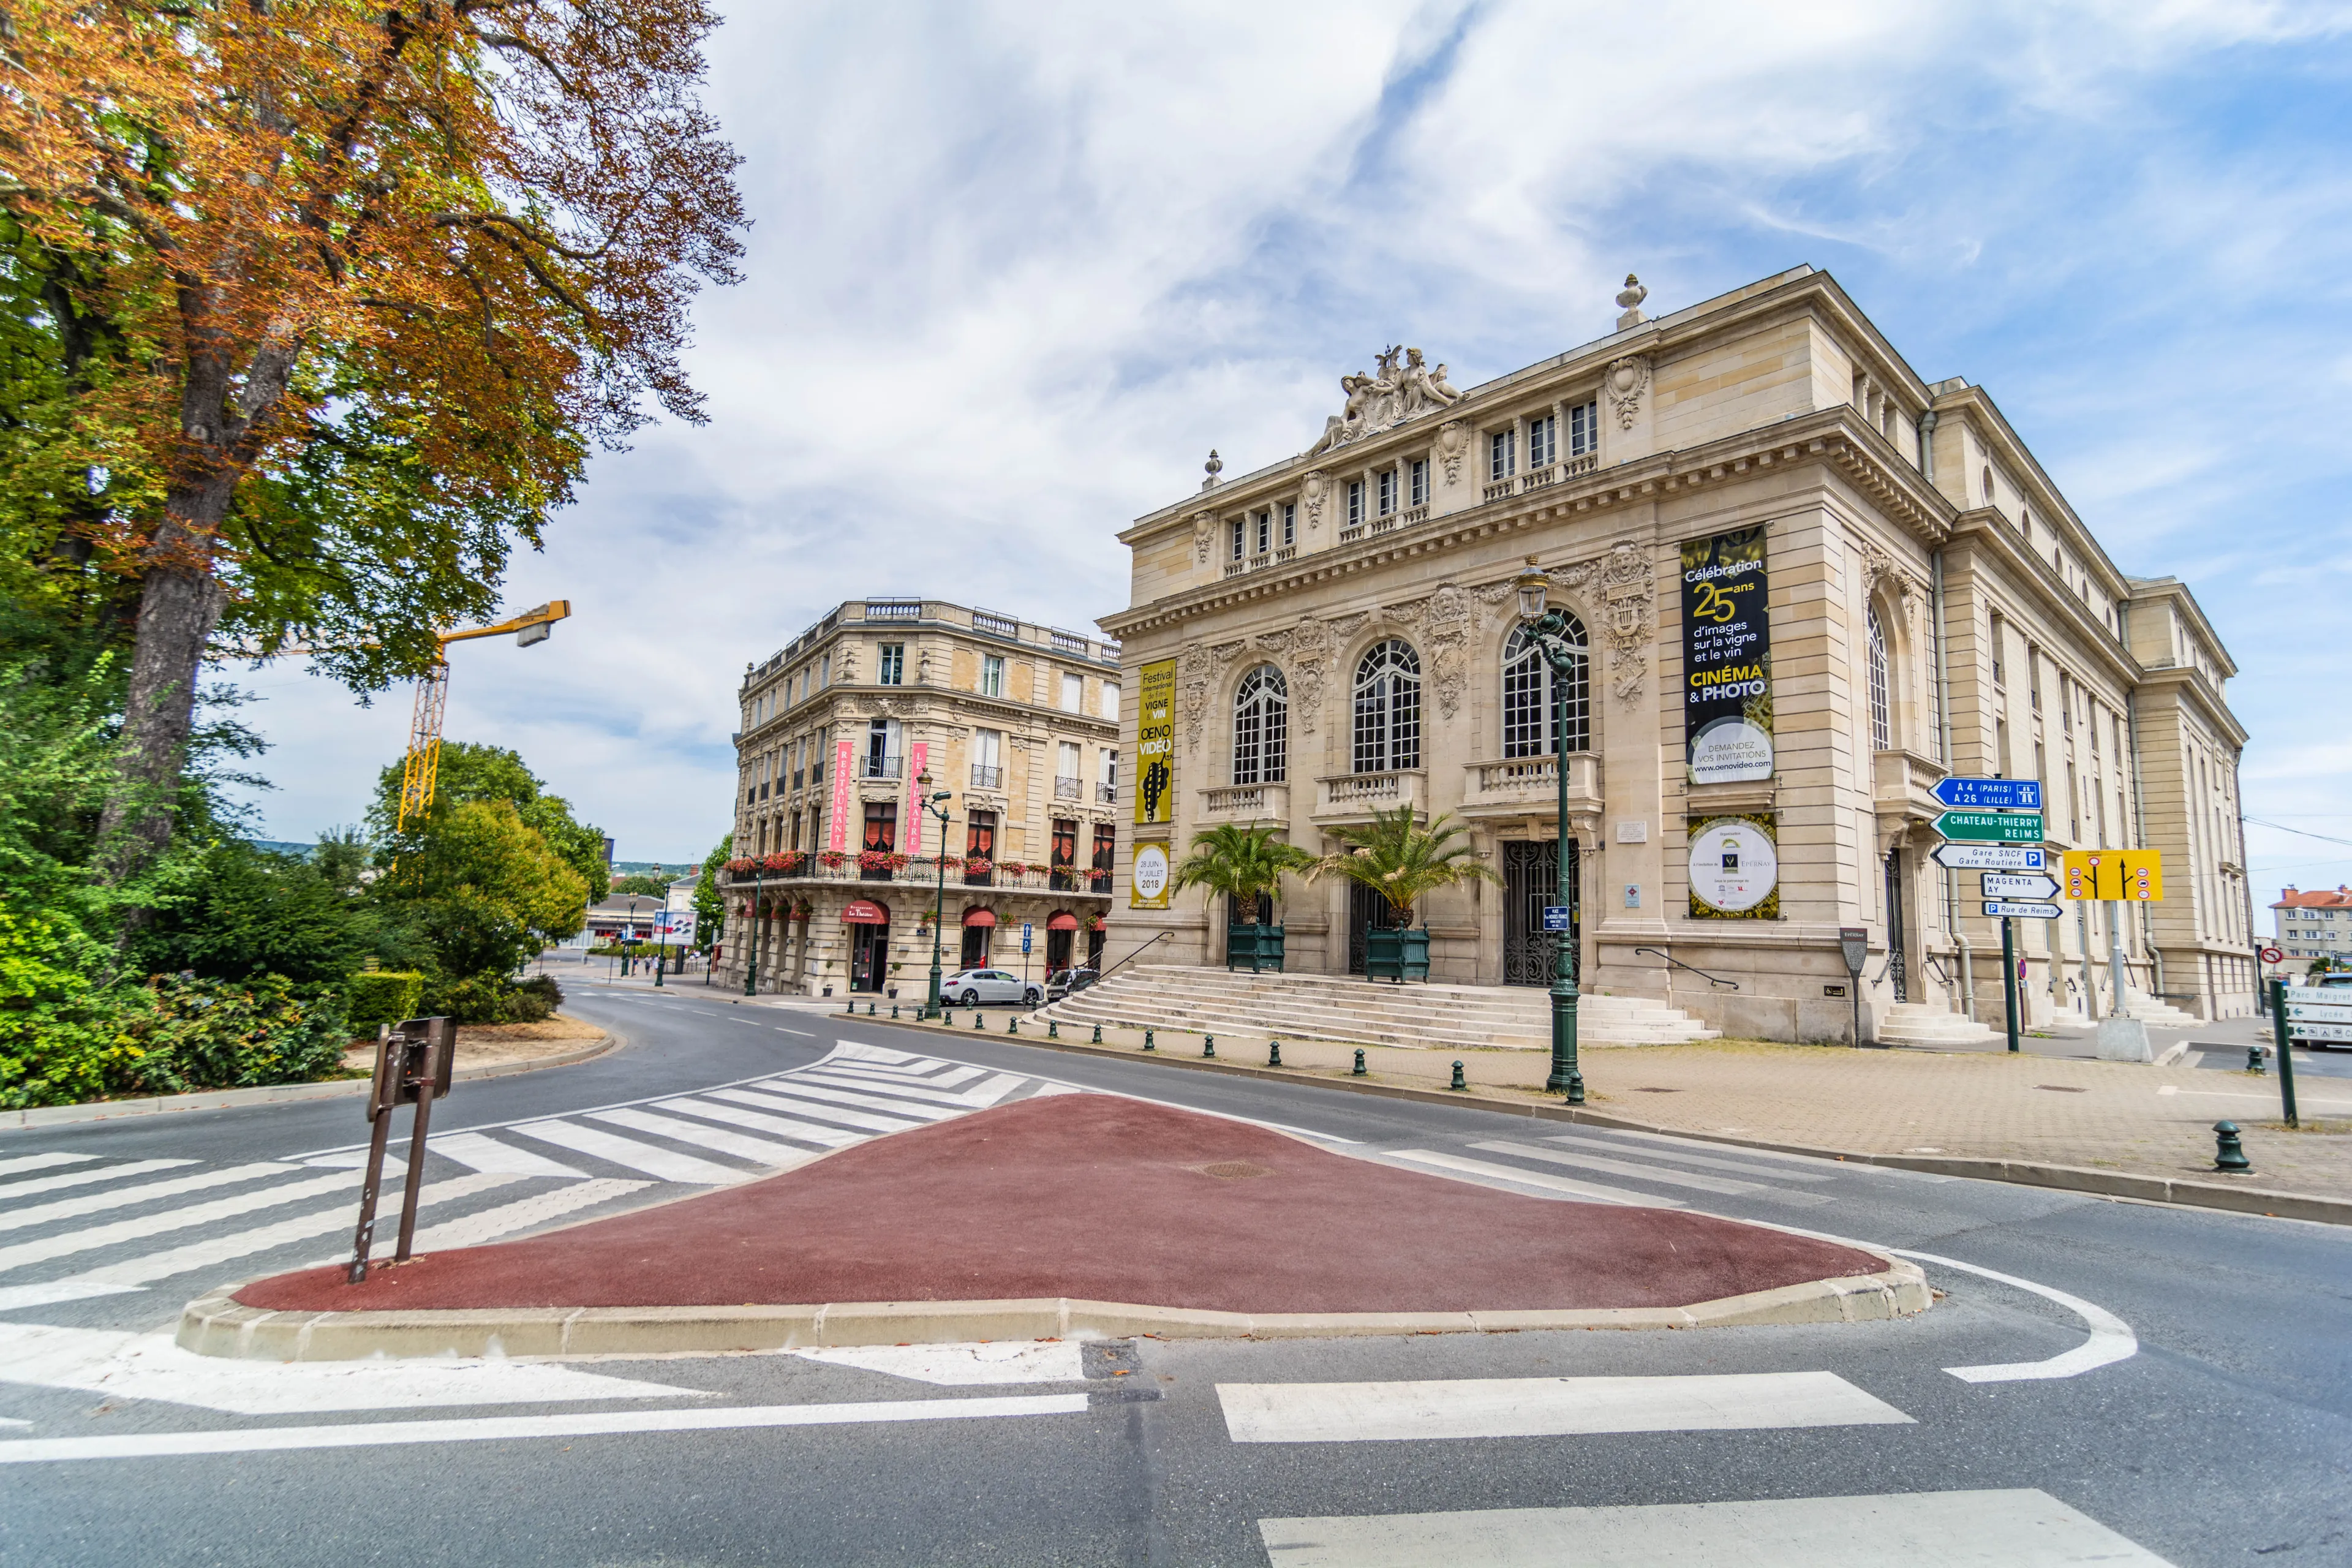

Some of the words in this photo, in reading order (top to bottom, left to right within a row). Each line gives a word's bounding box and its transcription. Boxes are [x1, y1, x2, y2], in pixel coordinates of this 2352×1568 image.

[1685, 560, 1762, 582] Célébration
[1610, 586, 1640, 597] OPERA
[1694, 582, 1735, 622] 25
[1733, 582, 1754, 593] ans
[1694, 622, 1747, 638] d'images
[1694, 640, 1711, 650] sur
[1713, 636, 1722, 647] la
[1725, 633, 1757, 646] vigne
[1695, 652, 1706, 662] et
[1710, 649, 1721, 660] le
[1724, 647, 1741, 657] vin
[1143, 666, 1173, 684] Festival
[1691, 665, 1763, 687] CINÉMA
[1143, 679, 1172, 692] international
[1690, 692, 1699, 703] &
[1703, 680, 1765, 701] PHOTO
[1145, 699, 1168, 710] VIGNE
[1153, 709, 1166, 720] VIN
[1139, 737, 1171, 755] VIDÉO
[1708, 742, 1755, 752] DEMANDEZ
[916, 753, 922, 769] LE
[1716, 750, 1766, 761] INVITATIONS
[1694, 761, 1771, 772] www.oenovideo.com
[1957, 783, 1964, 791] A
[1967, 783, 1973, 791] 4
[1980, 784, 2011, 793] (PARIS)
[835, 751, 848, 843] RESTAURANT
[1954, 794, 1960, 802] A
[1964, 794, 1977, 803] 26
[1983, 796, 2012, 804] (LILLE)
[1950, 815, 2038, 827] CHATEAU-THIERRY
[2005, 829, 2040, 839] REIMS
[2029, 853, 2038, 865] P
[1142, 880, 1159, 888] 2018
[1987, 877, 2032, 886] MAGENTA
